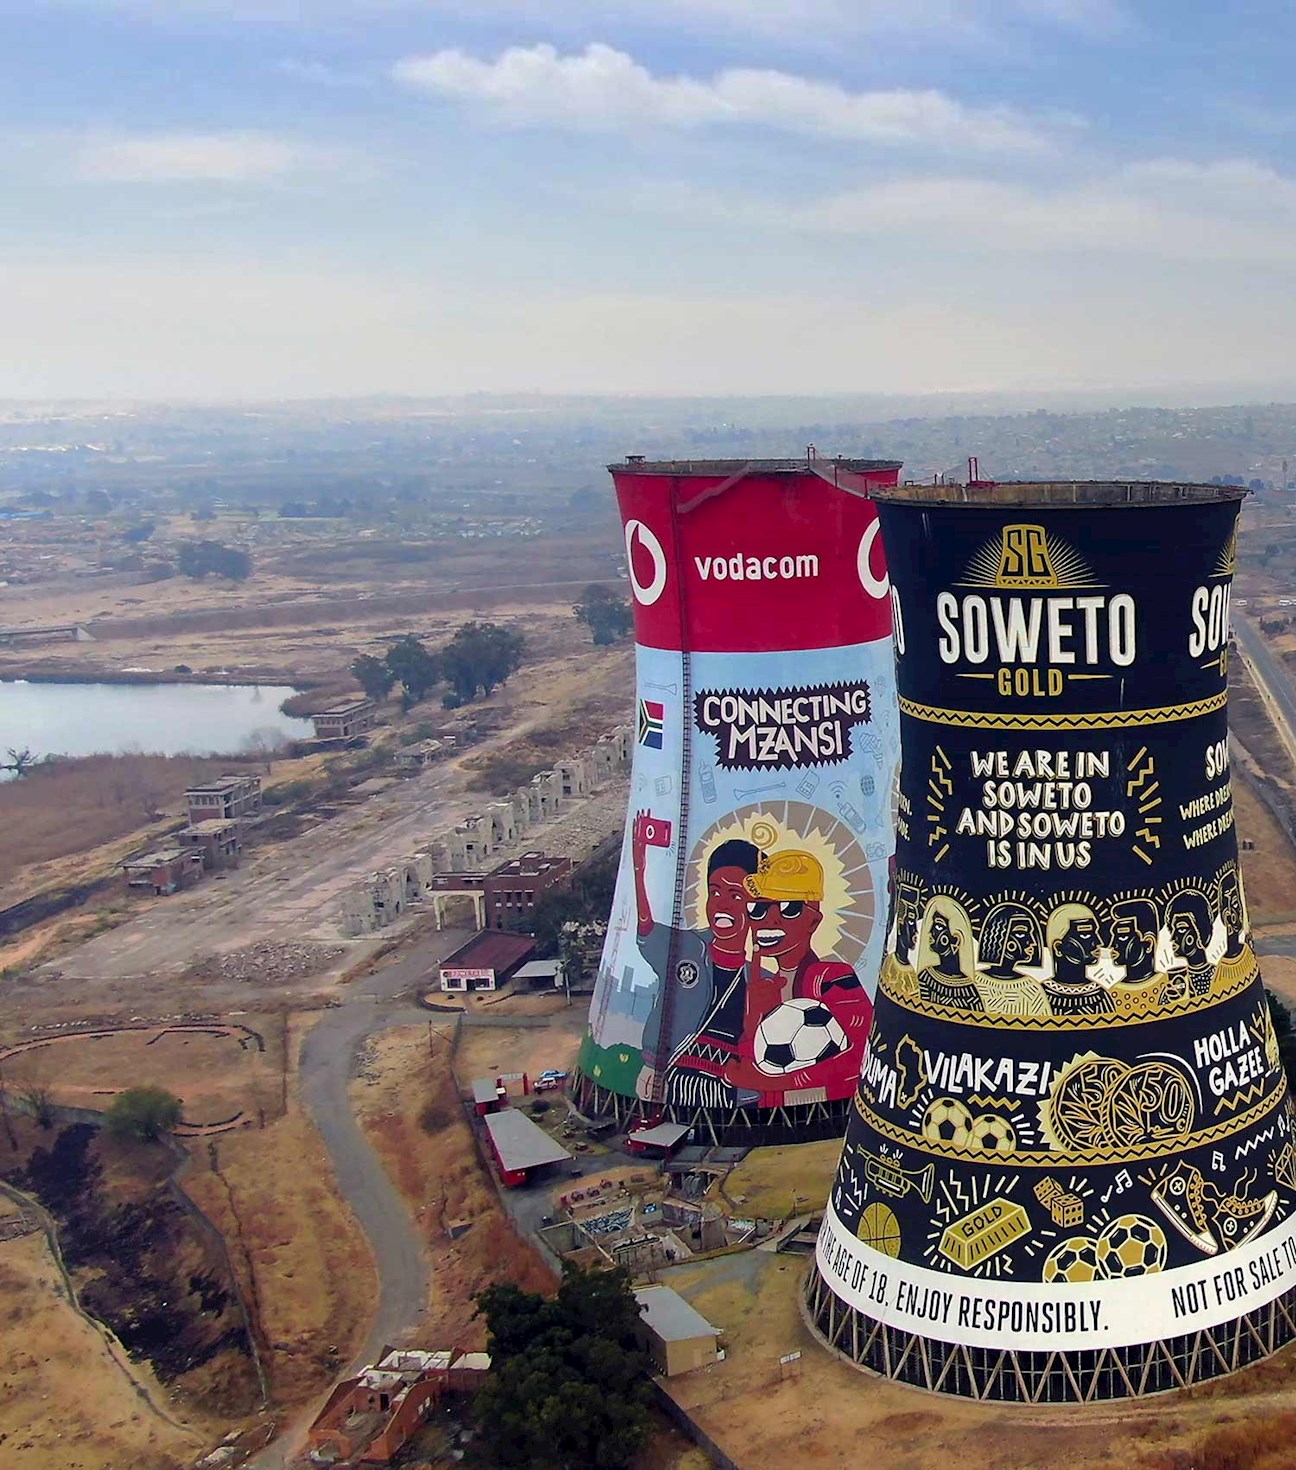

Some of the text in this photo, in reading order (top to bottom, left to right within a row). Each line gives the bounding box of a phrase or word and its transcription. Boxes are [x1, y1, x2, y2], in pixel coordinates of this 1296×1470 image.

[694, 552, 819, 581] vodacom
[936, 590, 1137, 667] SOWETO
[997, 667, 1064, 697] GOLD
[702, 689, 868, 727] CONNECTING
[728, 720, 844, 762] MZANSI
[970, 749, 1110, 781] WE ARE IN
[982, 779, 1092, 810] SOWETO
[1179, 792, 1216, 821] WHERE
[955, 807, 1126, 840] AND SOWETO
[1182, 819, 1220, 850] WHERE
[986, 839, 1092, 871] IS IN US
[1193, 1019, 1251, 1069] HOLLA
[923, 1049, 1051, 1096] VILAKAZI
[1208, 1046, 1265, 1097] GAZEE
[961, 1205, 1003, 1238] GOLD
[831, 1244, 853, 1283] AGE
[851, 1259, 869, 1293] OF
[868, 1270, 889, 1307] 18.
[895, 1280, 953, 1324] ENJOY
[957, 1295, 1110, 1334] RESPONSIBLY.
[1171, 1279, 1209, 1319] NOT
[1213, 1266, 1249, 1306] FOR
[1249, 1246, 1284, 1291] SALE
